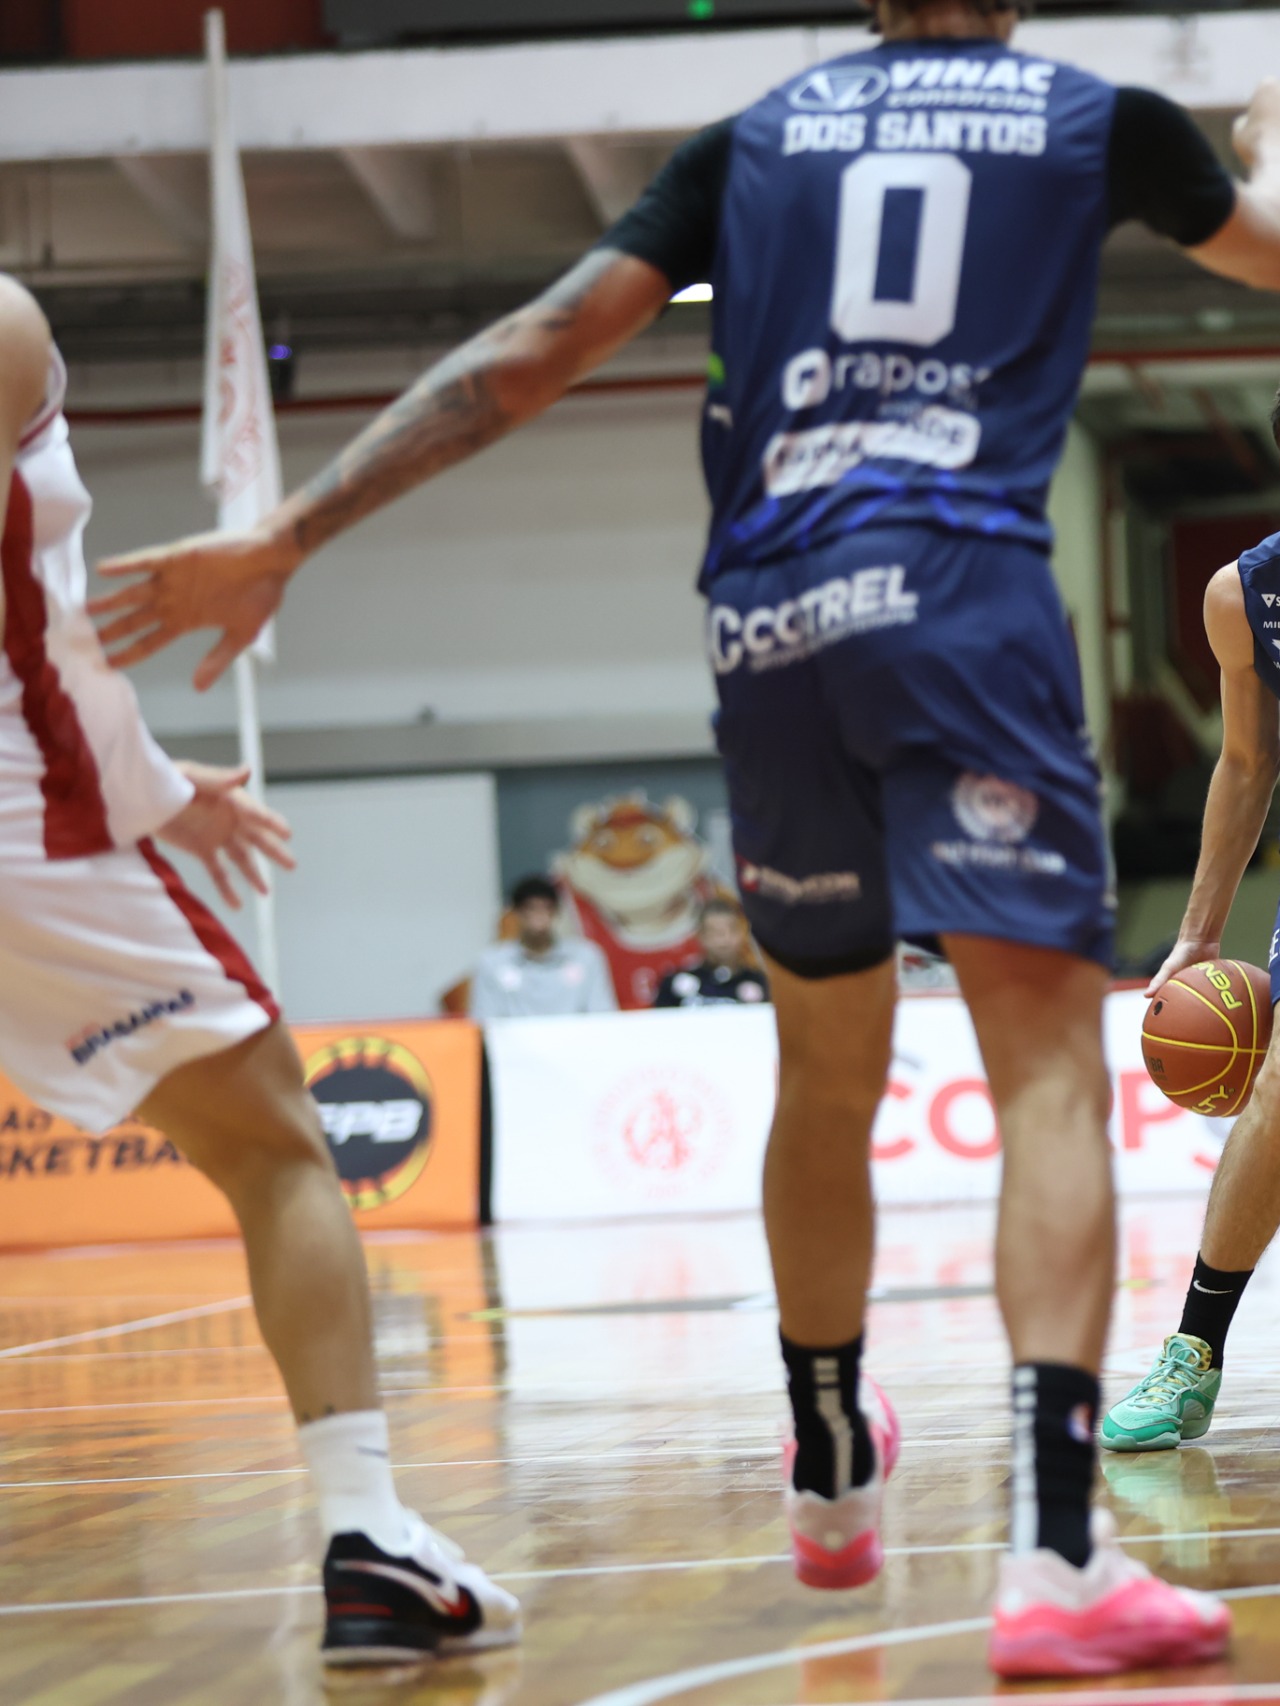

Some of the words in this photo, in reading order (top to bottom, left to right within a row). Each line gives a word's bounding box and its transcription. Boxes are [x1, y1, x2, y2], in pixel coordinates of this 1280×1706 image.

[887, 58, 1056, 95] VINAC
[781, 112, 868, 156] DOS
[875, 110, 1048, 157] SANTOS
[832, 152, 972, 347] 0
